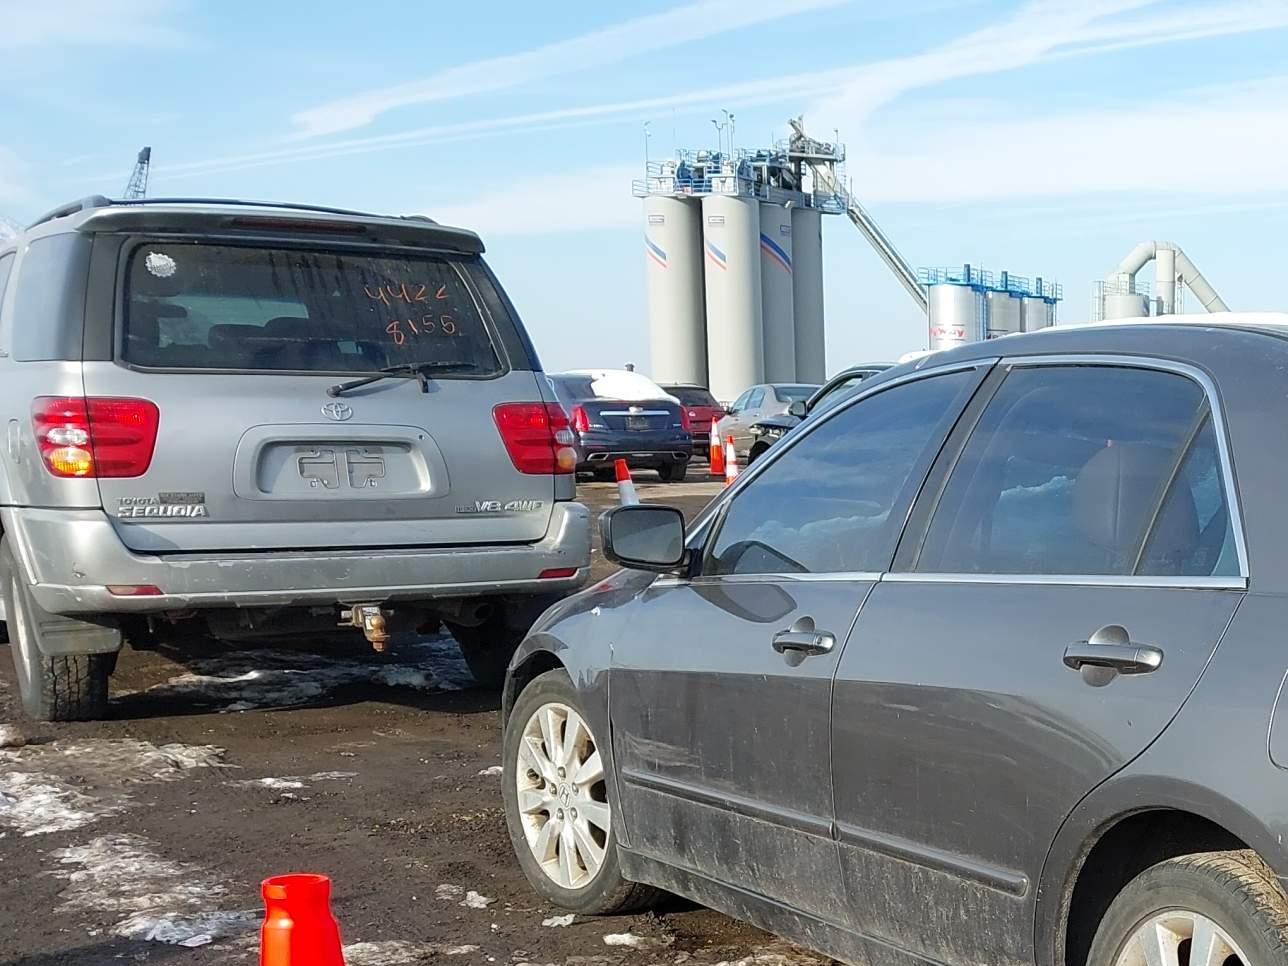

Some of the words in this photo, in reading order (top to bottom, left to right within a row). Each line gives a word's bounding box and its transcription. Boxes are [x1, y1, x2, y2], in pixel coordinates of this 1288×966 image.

[364, 283, 449, 306] 4422
[385, 314, 455, 345] 8155
[117, 505, 209, 518] SEQUOIA
[474, 500, 502, 512] V8
